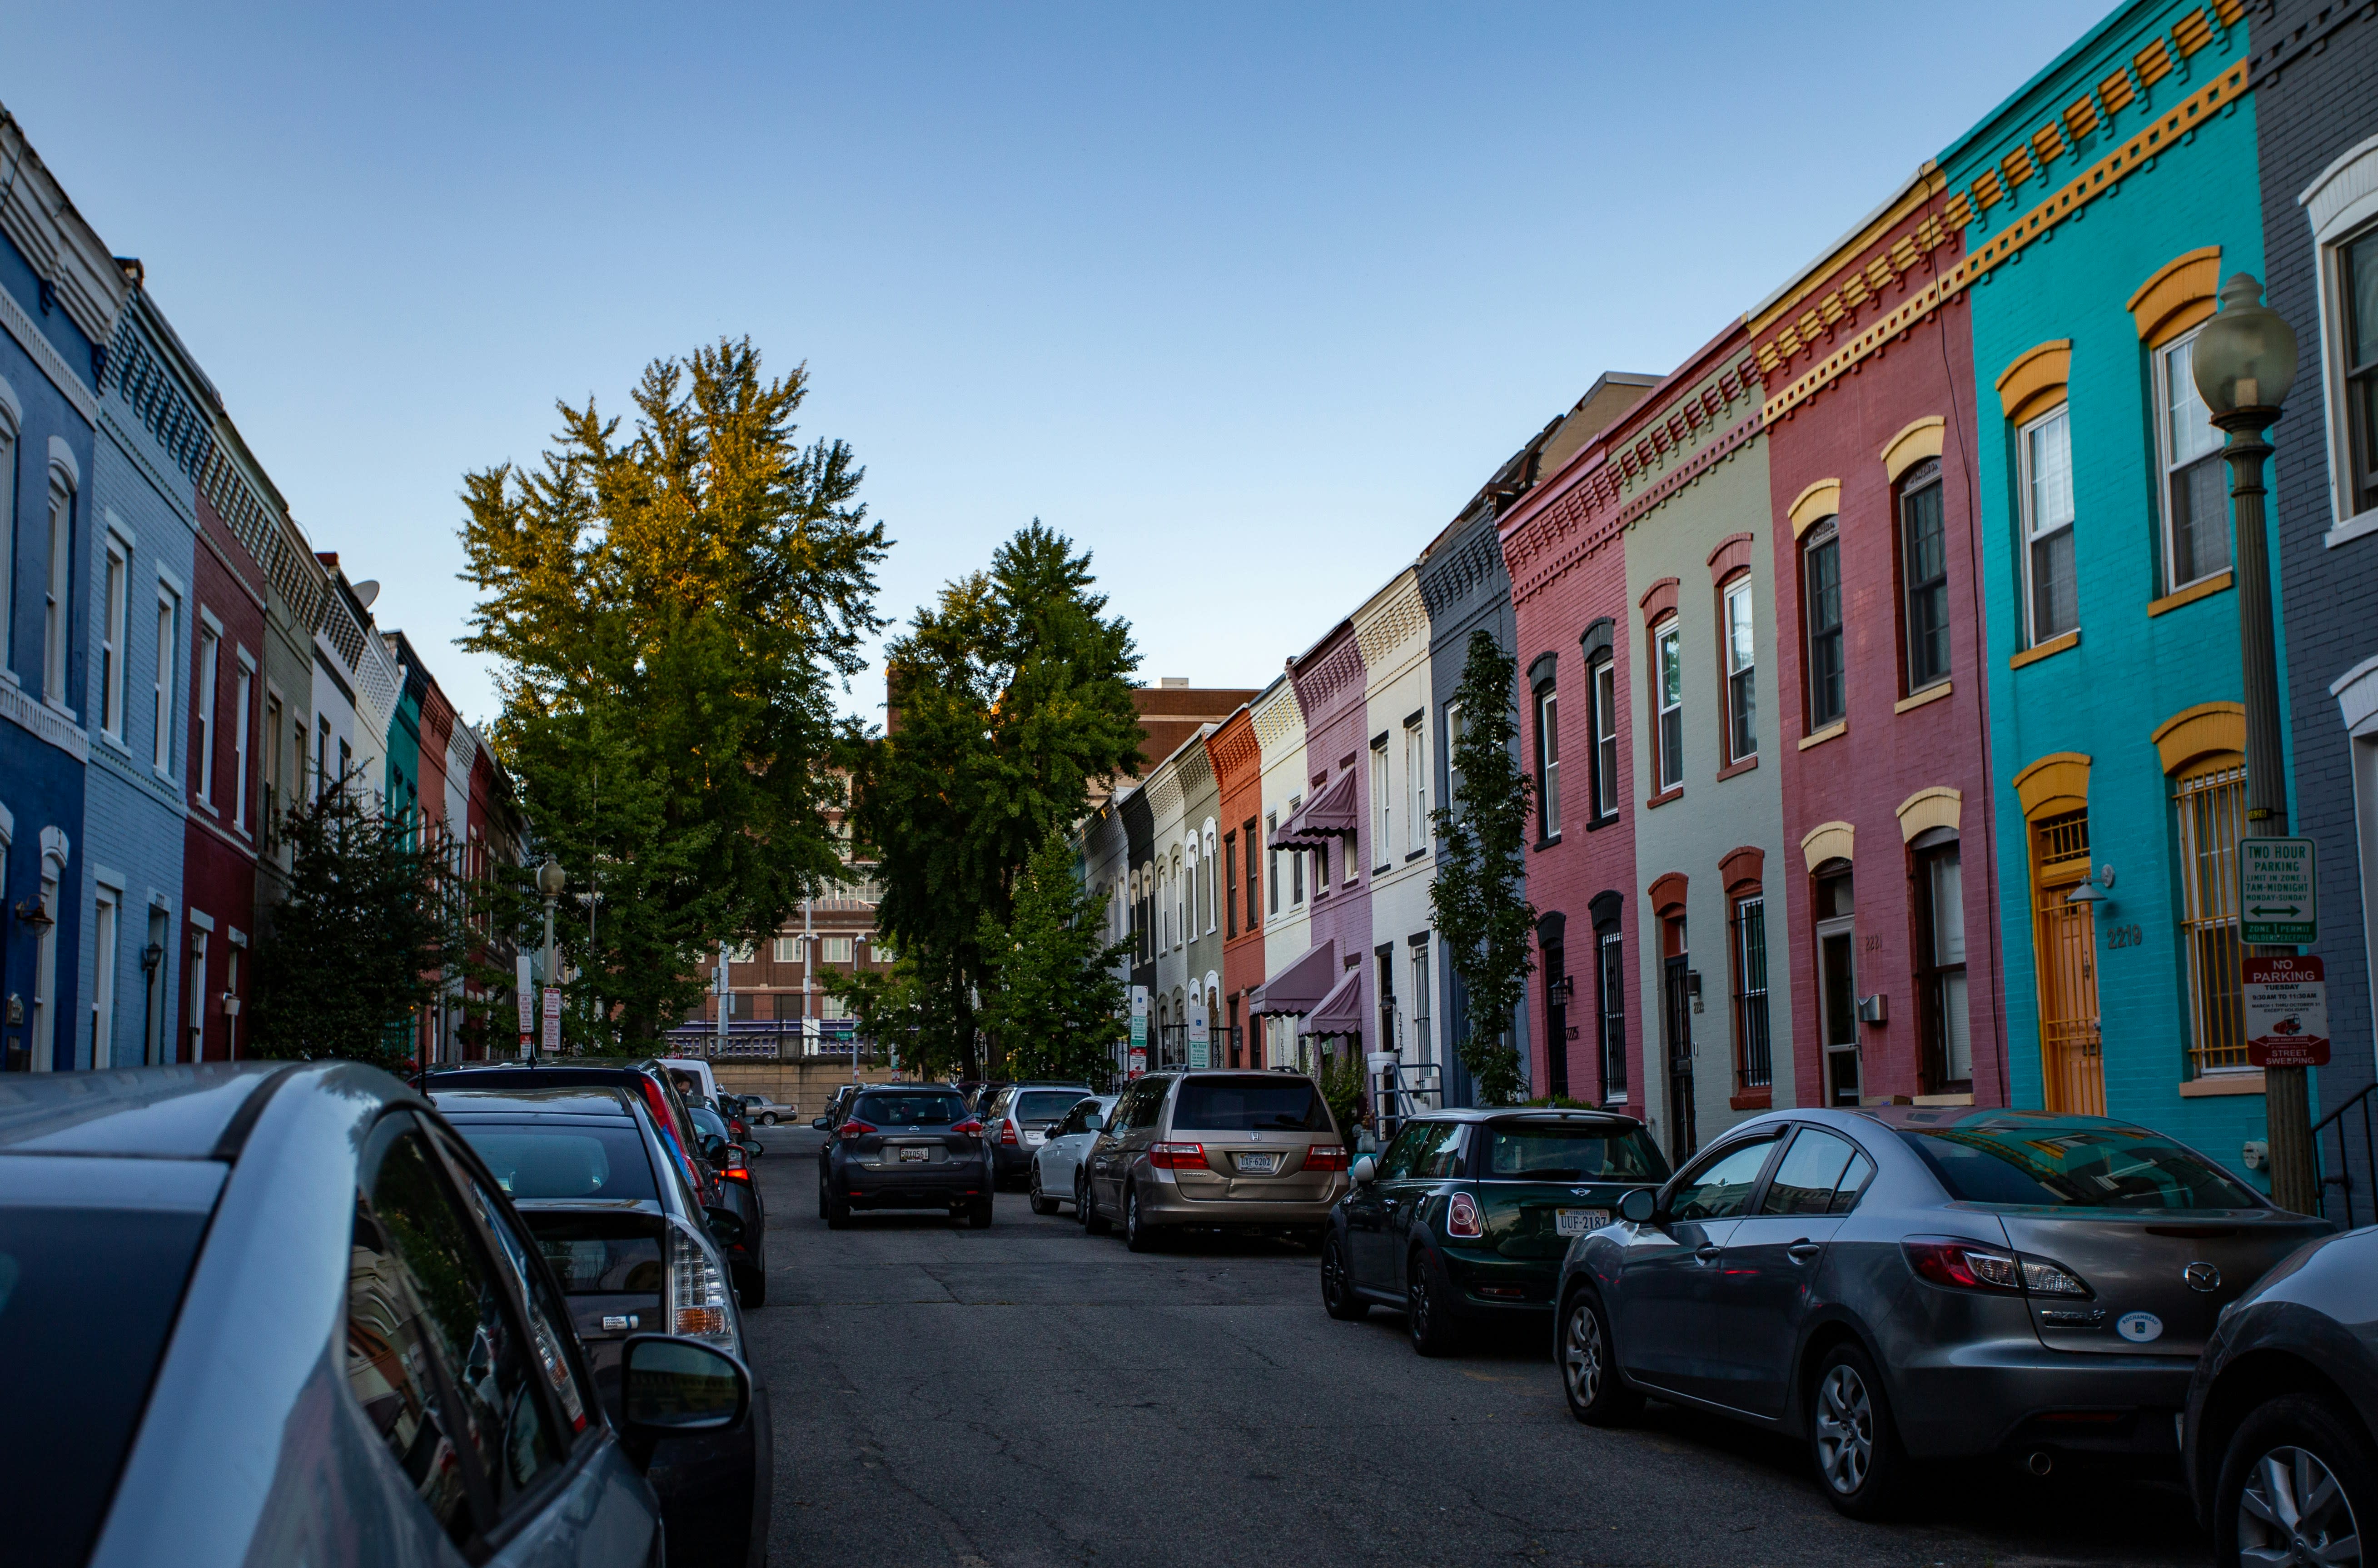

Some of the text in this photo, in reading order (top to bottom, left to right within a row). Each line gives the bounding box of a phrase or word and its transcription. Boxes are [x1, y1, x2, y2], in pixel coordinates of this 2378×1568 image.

[2248, 846, 2305, 858] TWO HOUR
[2254, 861, 2299, 871] PARKING
[2246, 883, 2308, 891] 7AM-MIDNIGHT
[2108, 923, 2141, 949] 2219
[1866, 934, 1882, 952] 2221
[2273, 959, 2293, 970] NO
[2253, 971, 2315, 982] PARKING
[2266, 1056, 2315, 1065] SWEEPING
[1242, 1158, 1270, 1166] UXF-6202
[1561, 1216, 1606, 1229] UUF-2187
[2041, 1310, 2088, 1320] mazda
[2122, 1314, 2159, 1325] ROCHAMBEAU
